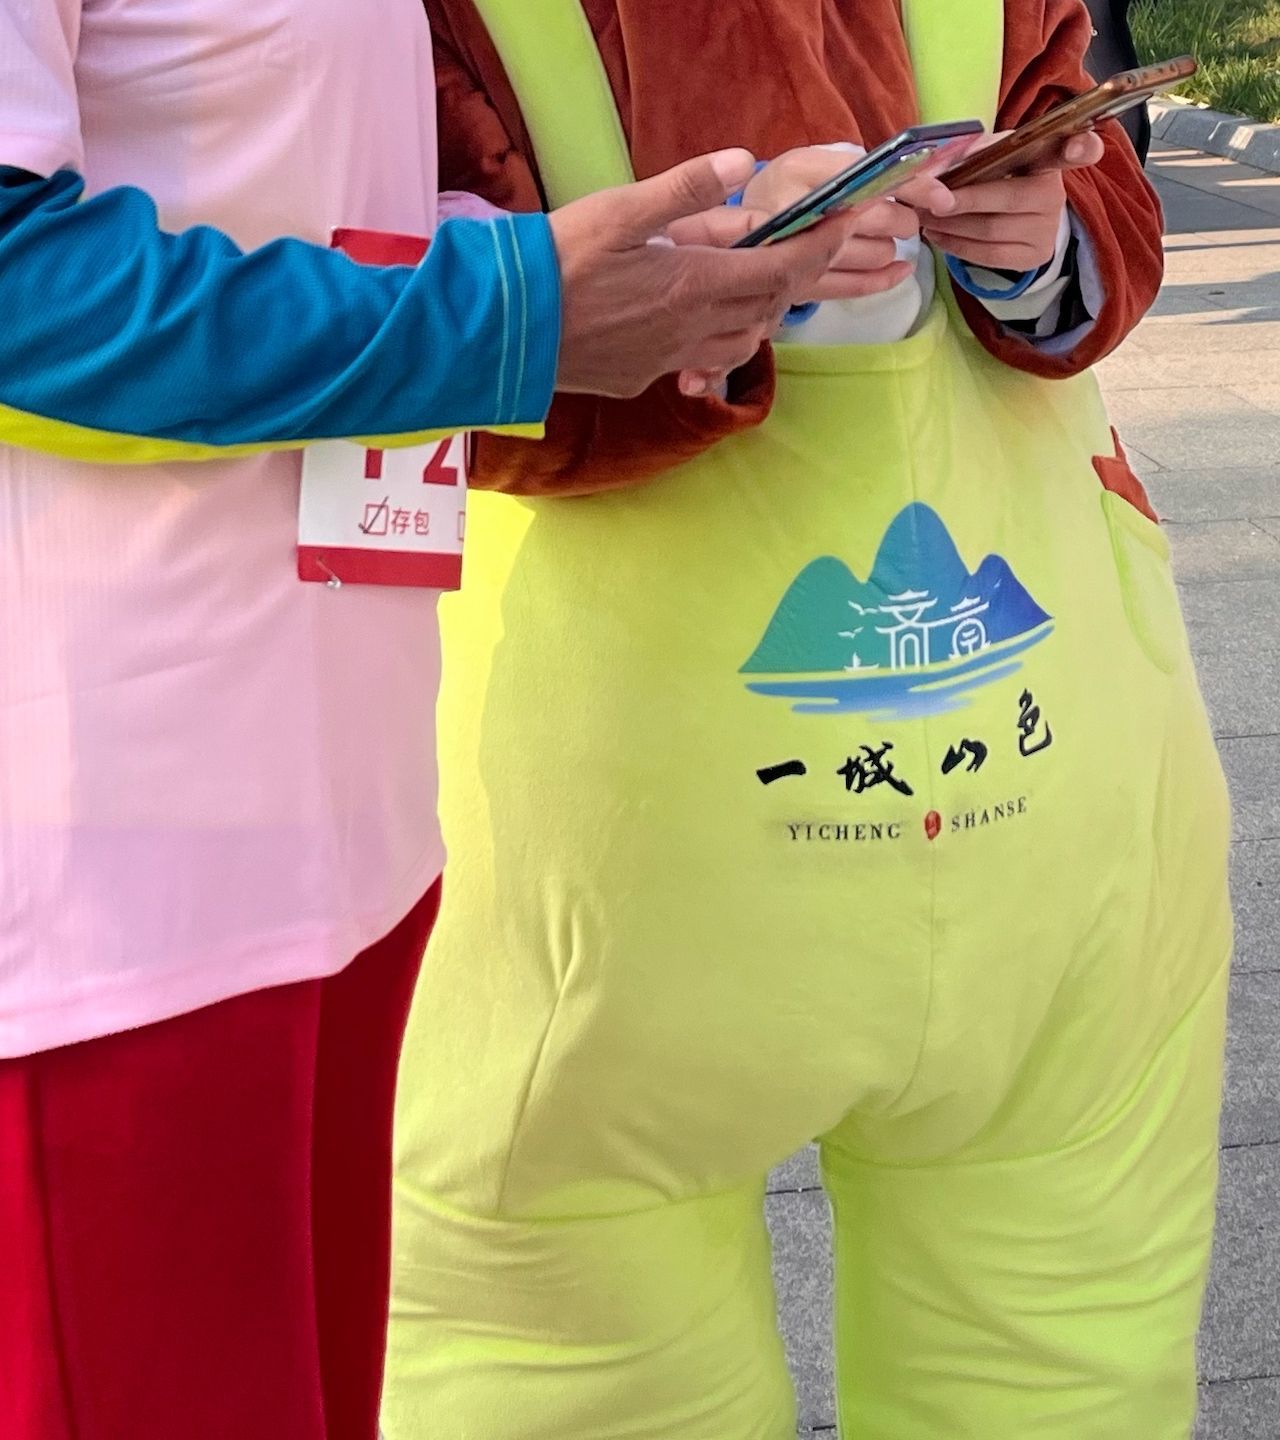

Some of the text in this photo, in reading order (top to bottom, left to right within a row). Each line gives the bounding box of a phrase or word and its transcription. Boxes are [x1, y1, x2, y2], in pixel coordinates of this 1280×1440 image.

[391, 509, 430, 535] 存包
[756, 688, 1053, 796] 一城山色
[788, 796, 1028, 841] YICHENG SHANSE
